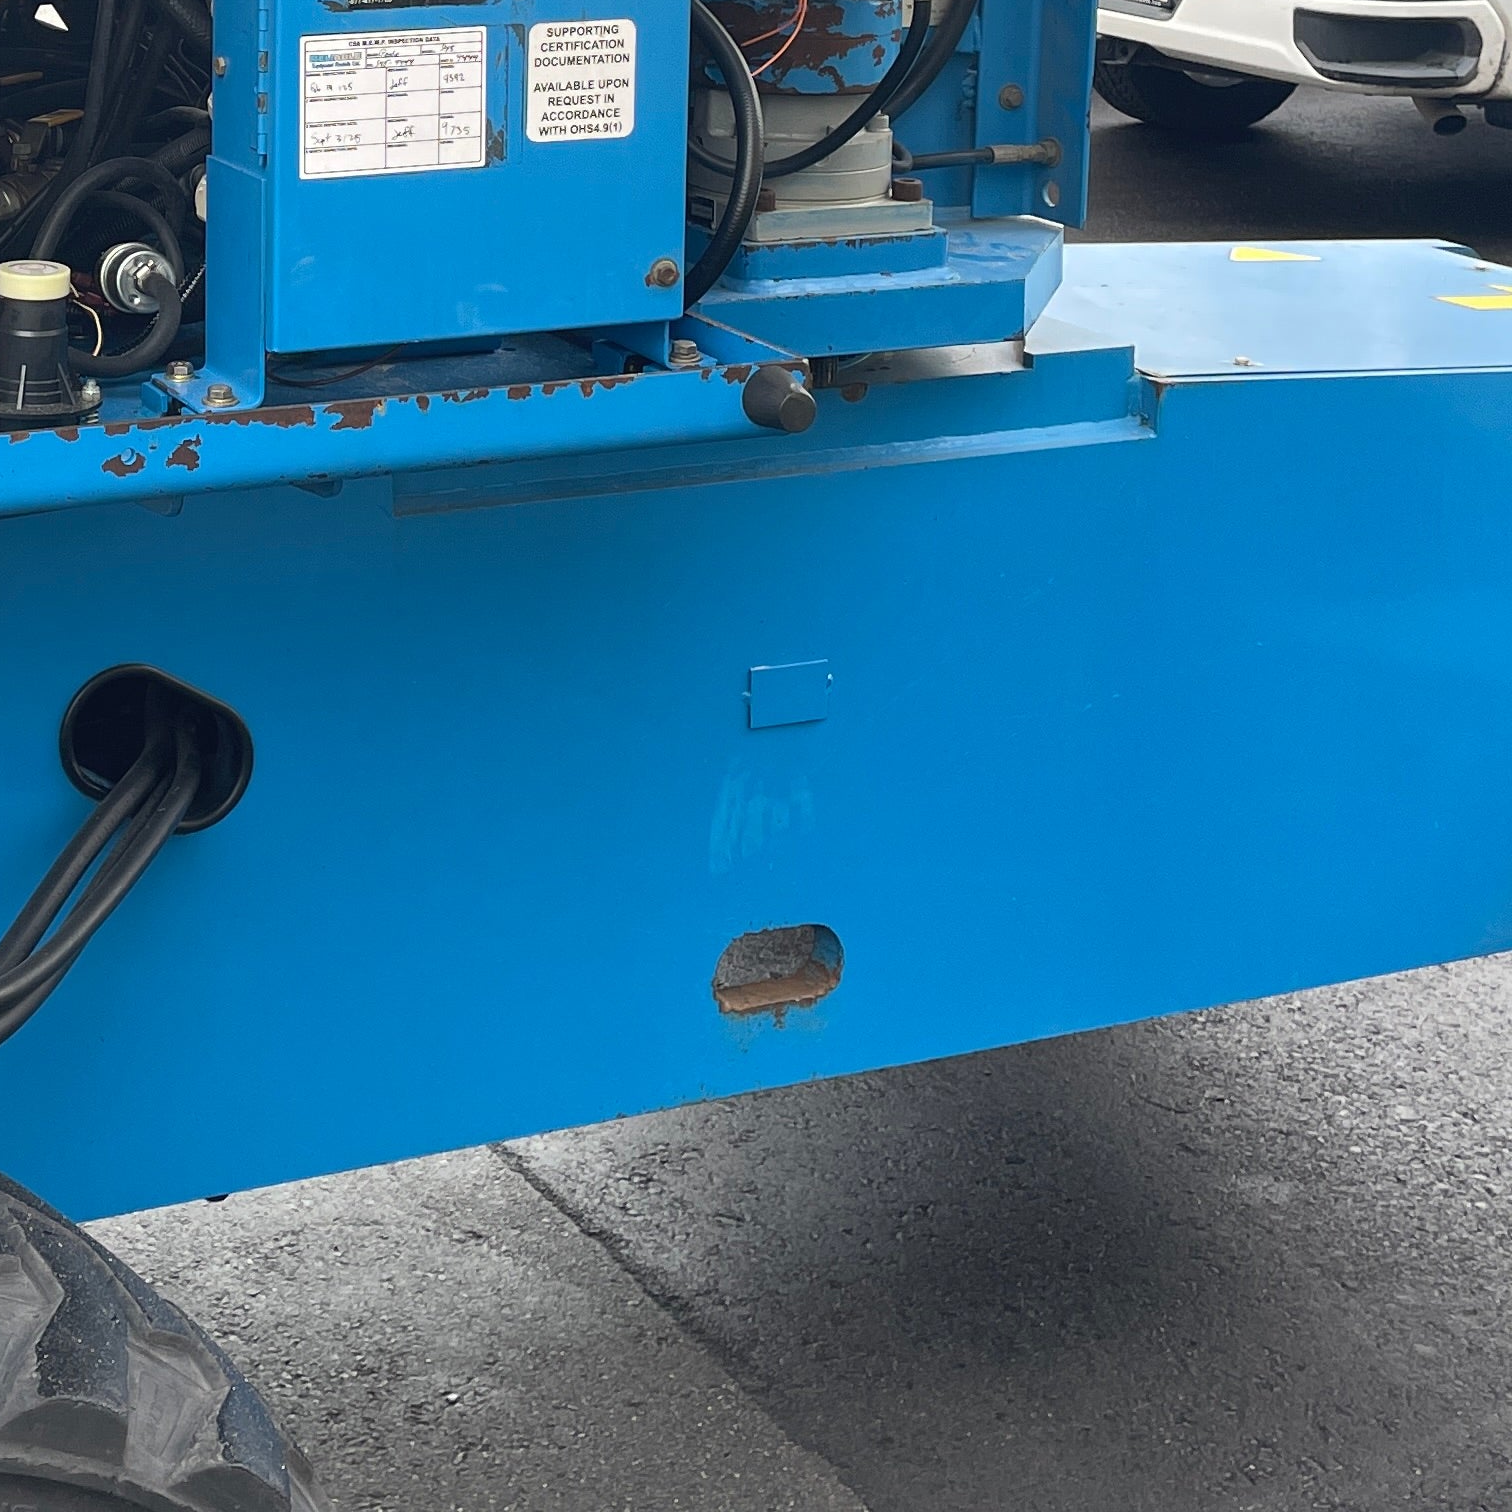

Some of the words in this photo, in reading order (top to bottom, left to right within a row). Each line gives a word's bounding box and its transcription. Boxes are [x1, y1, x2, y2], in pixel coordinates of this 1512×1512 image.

[546, 24, 619, 38] SUPPORTING
[388, 36, 424, 45] INSPECTION
[540, 38, 625, 53] CERTIFICATION
[534, 53, 630, 68] DOCUMENTATION
[533, 79, 595, 93] AVAILABLE
[598, 78, 630, 90] UPON
[547, 94, 602, 107] REQUEST
[604, 93, 615, 104] IN
[540, 107, 621, 122] ACCORDANCE
[538, 125, 567, 137] WITH
[569, 120, 623, 135] OHS4.9(1)
